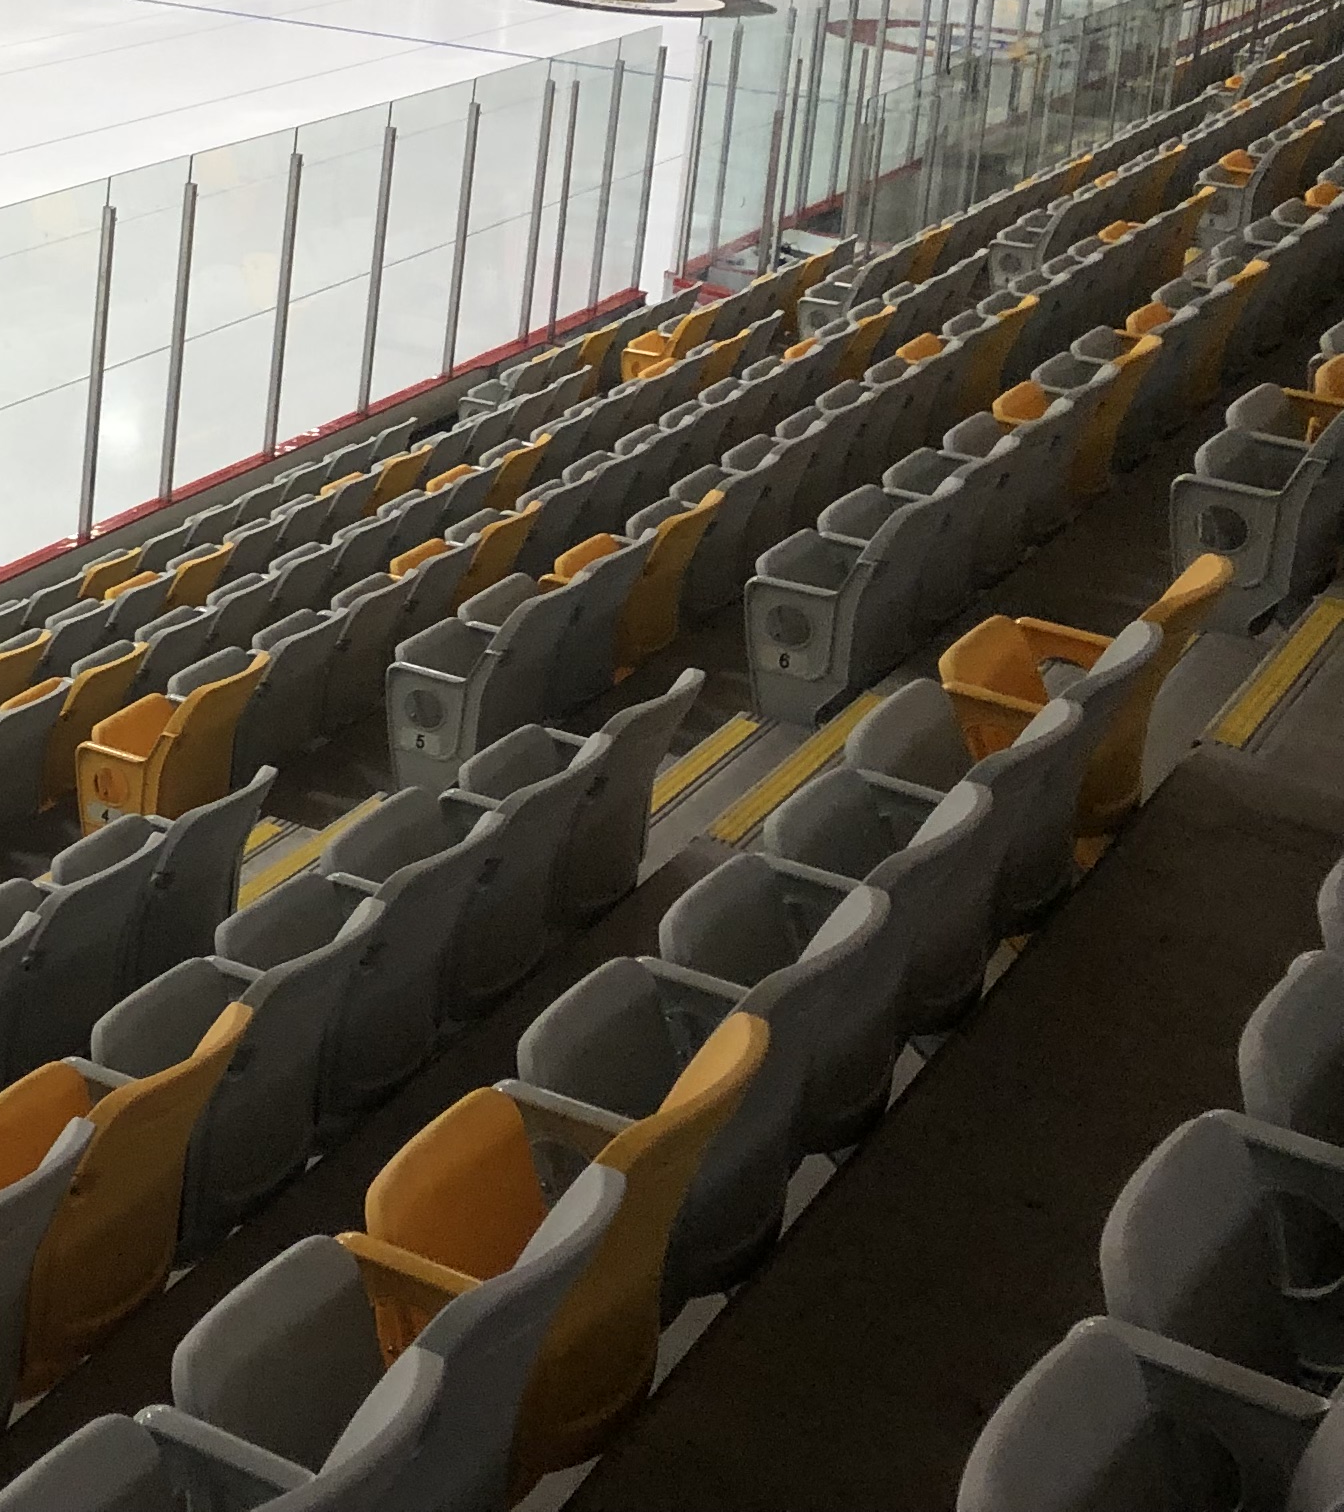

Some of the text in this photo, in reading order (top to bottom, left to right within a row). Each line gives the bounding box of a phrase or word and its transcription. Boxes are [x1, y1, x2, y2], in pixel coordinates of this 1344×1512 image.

[778, 652, 790, 669] 6
[415, 733, 426, 749] 5
[100, 808, 110, 822] 4
